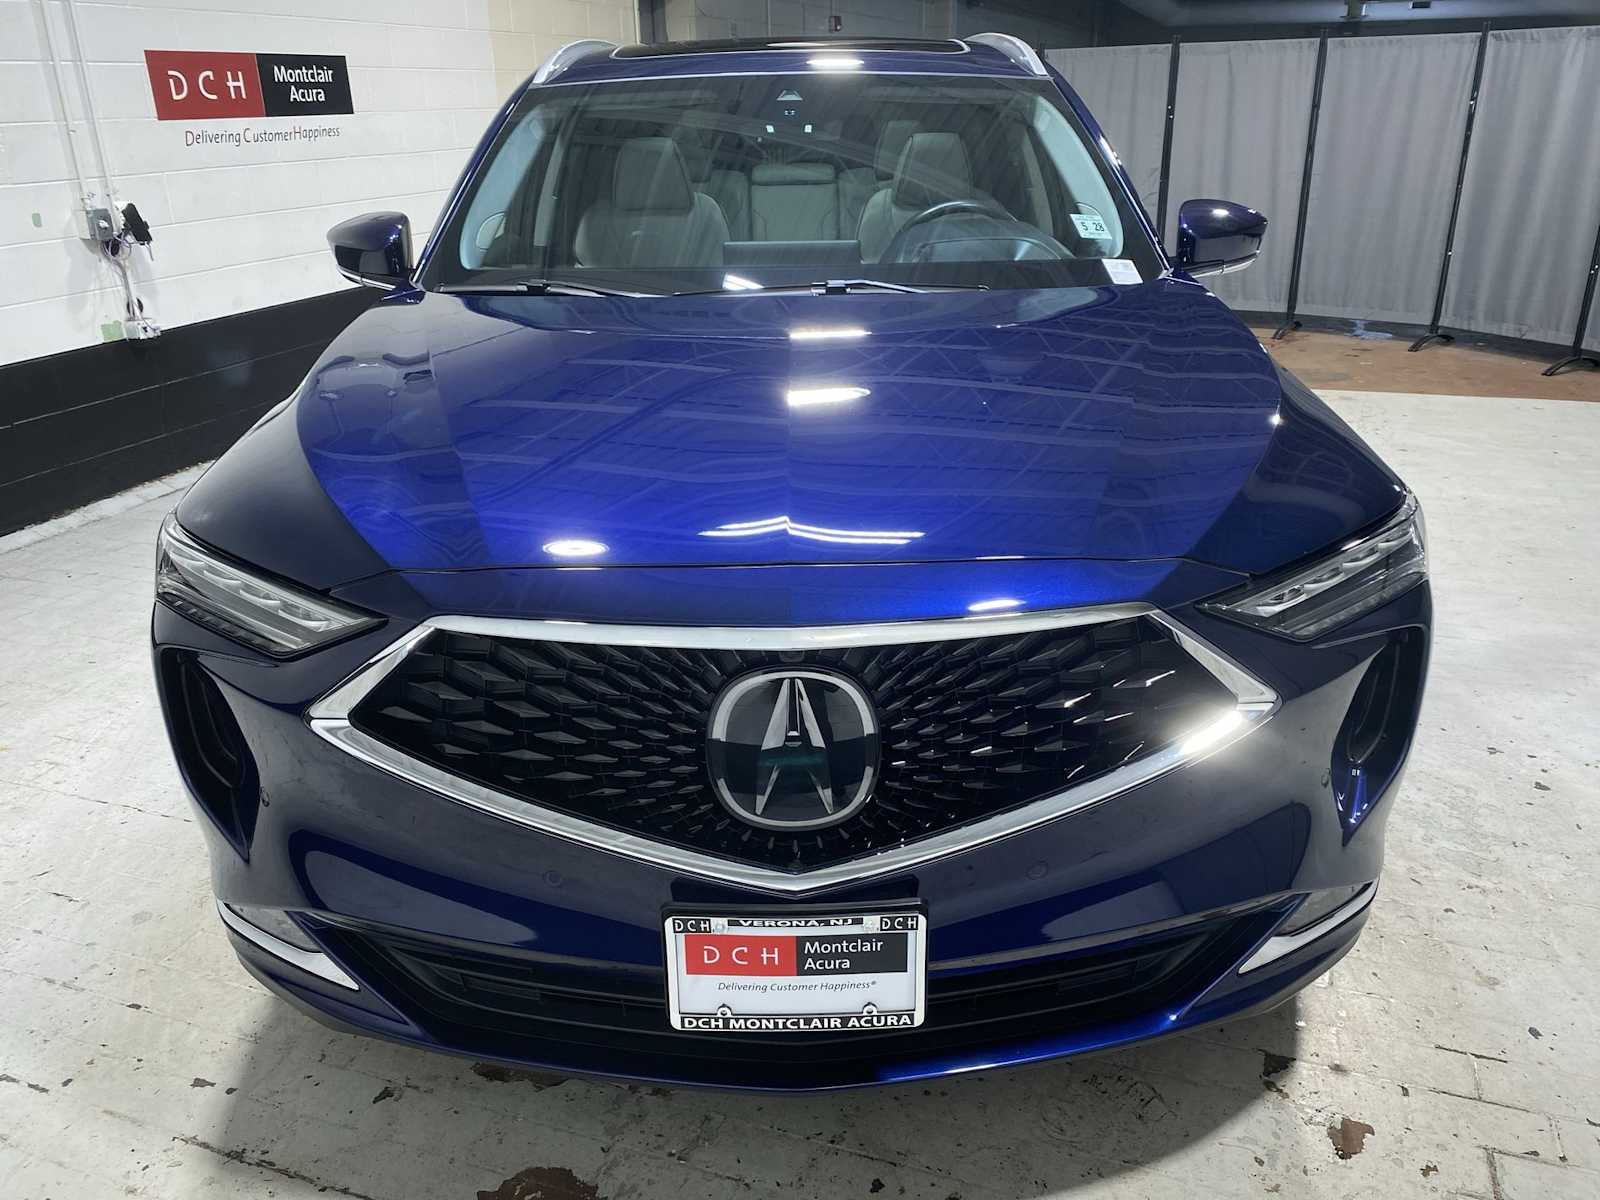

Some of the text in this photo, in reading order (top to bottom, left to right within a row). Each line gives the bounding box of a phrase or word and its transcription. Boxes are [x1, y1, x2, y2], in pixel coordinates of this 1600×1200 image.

[273, 65, 334, 83] Montclair
[167, 70, 247, 100] DCH
[290, 86, 326, 103] Acura
[185, 125, 341, 147] Delivering Customer Happiness
[1080, 222, 1105, 232] 5 28
[674, 919, 710, 932] DCH
[739, 918, 853, 927] VERONA, NJ
[881, 917, 917, 930] DCH
[804, 939, 884, 955] Montclair
[703, 945, 779, 965] DCH
[804, 956, 851, 970] Acura
[718, 981, 768, 994] Delivering
[770, 981, 818, 992] Customer
[684, 1015, 912, 1030] DCH MONTCLAIR ACURA
